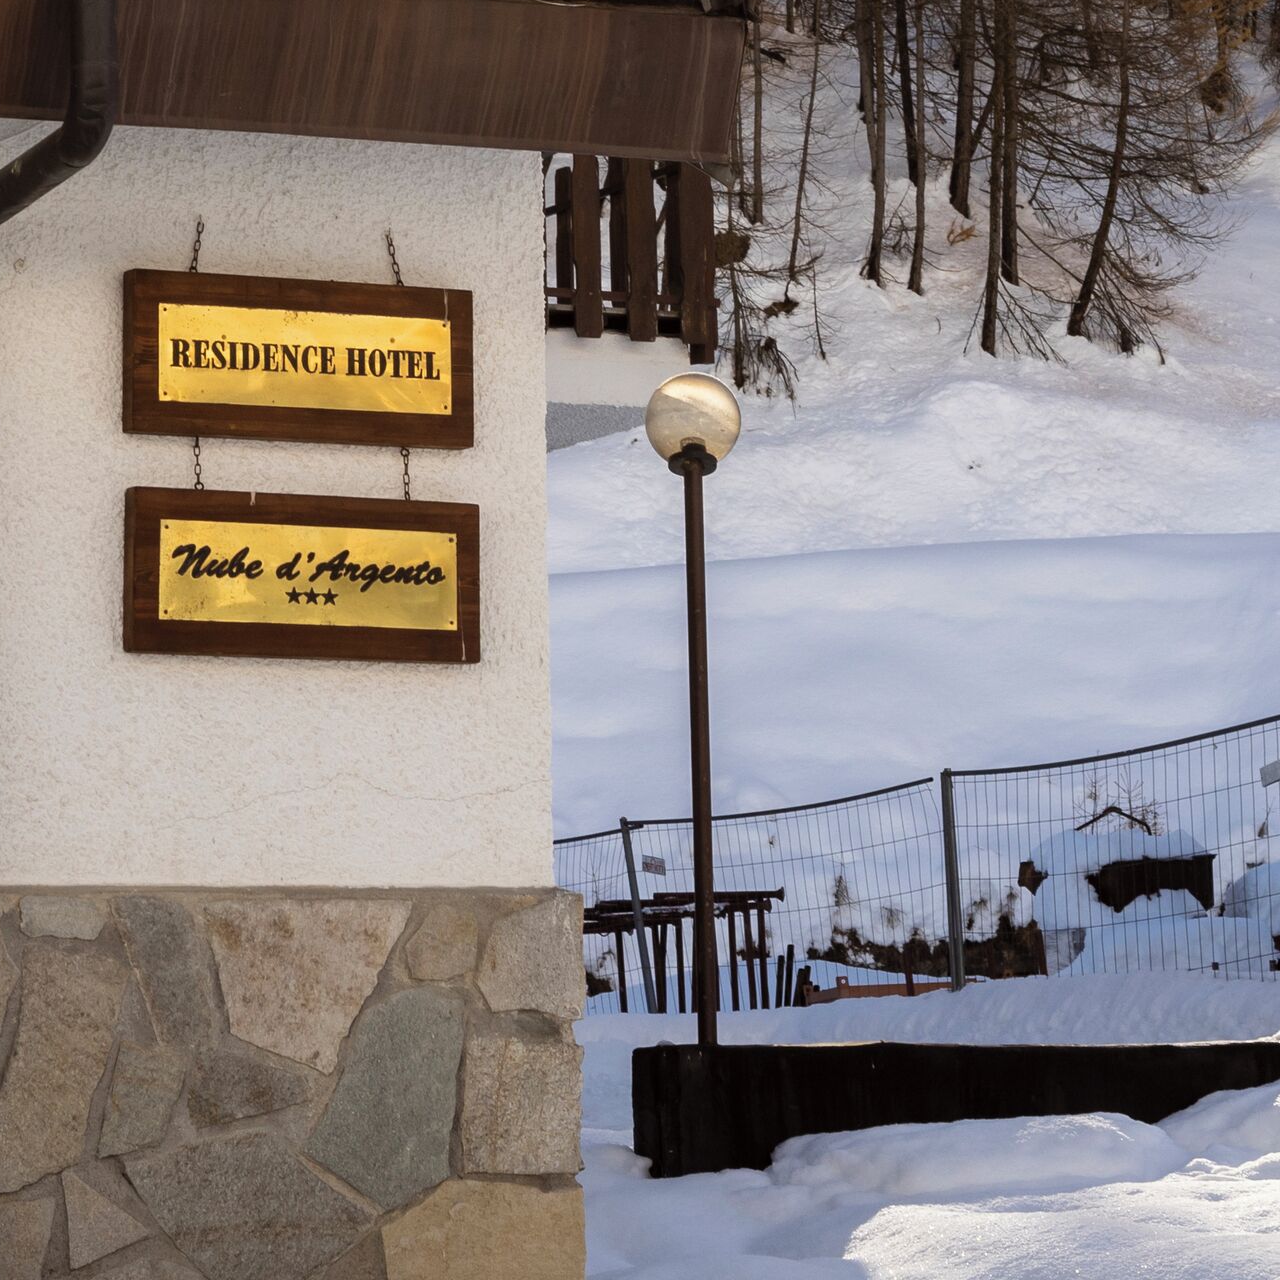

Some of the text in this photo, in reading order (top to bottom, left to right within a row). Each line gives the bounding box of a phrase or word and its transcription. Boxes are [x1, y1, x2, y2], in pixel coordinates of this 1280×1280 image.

[170, 337, 441, 381] RESIDENCE HOTEL
[172, 543, 446, 593] Nube d'Argento
